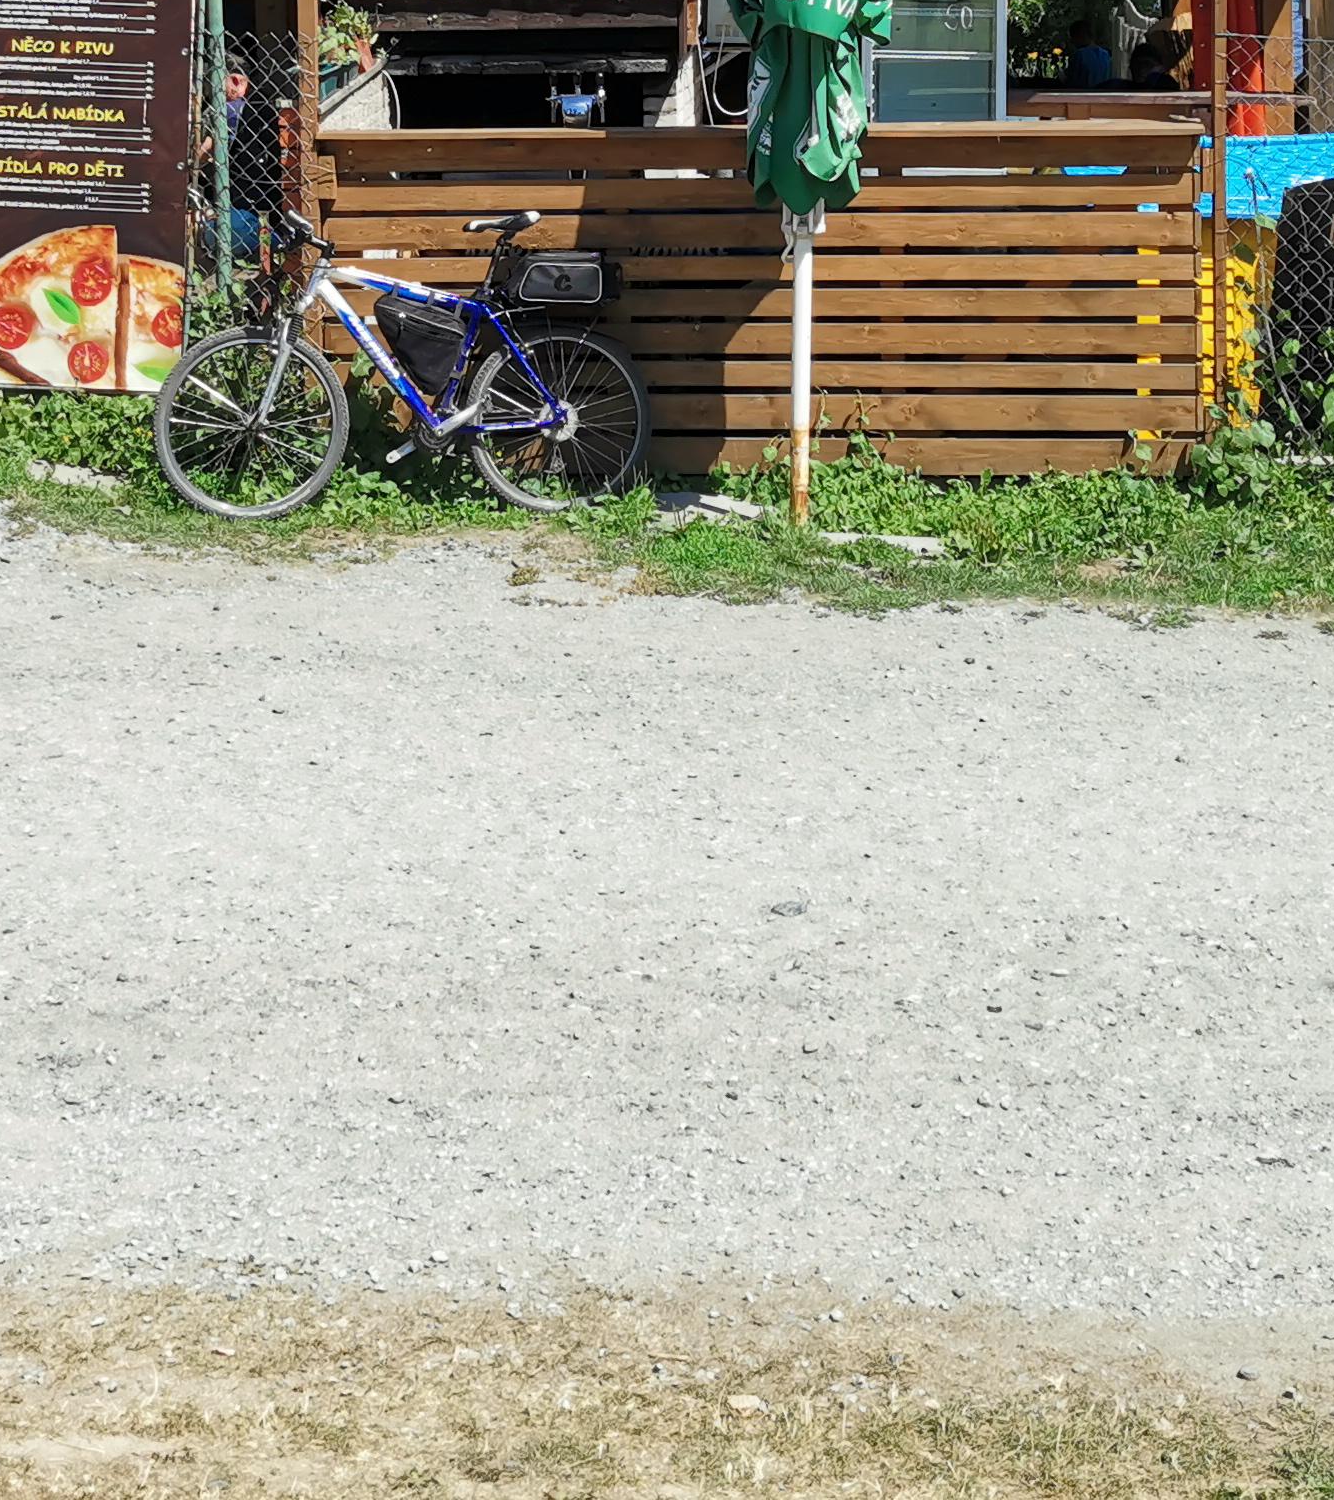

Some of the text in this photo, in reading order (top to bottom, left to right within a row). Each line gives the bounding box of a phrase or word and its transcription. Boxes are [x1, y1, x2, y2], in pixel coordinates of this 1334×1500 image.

[11, 36, 115, 56] NĚCO K PIVU
[53, 103, 126, 124] NABÍDKA
[48, 161, 78, 175] PRO
[84, 159, 126, 178] DĚTI
